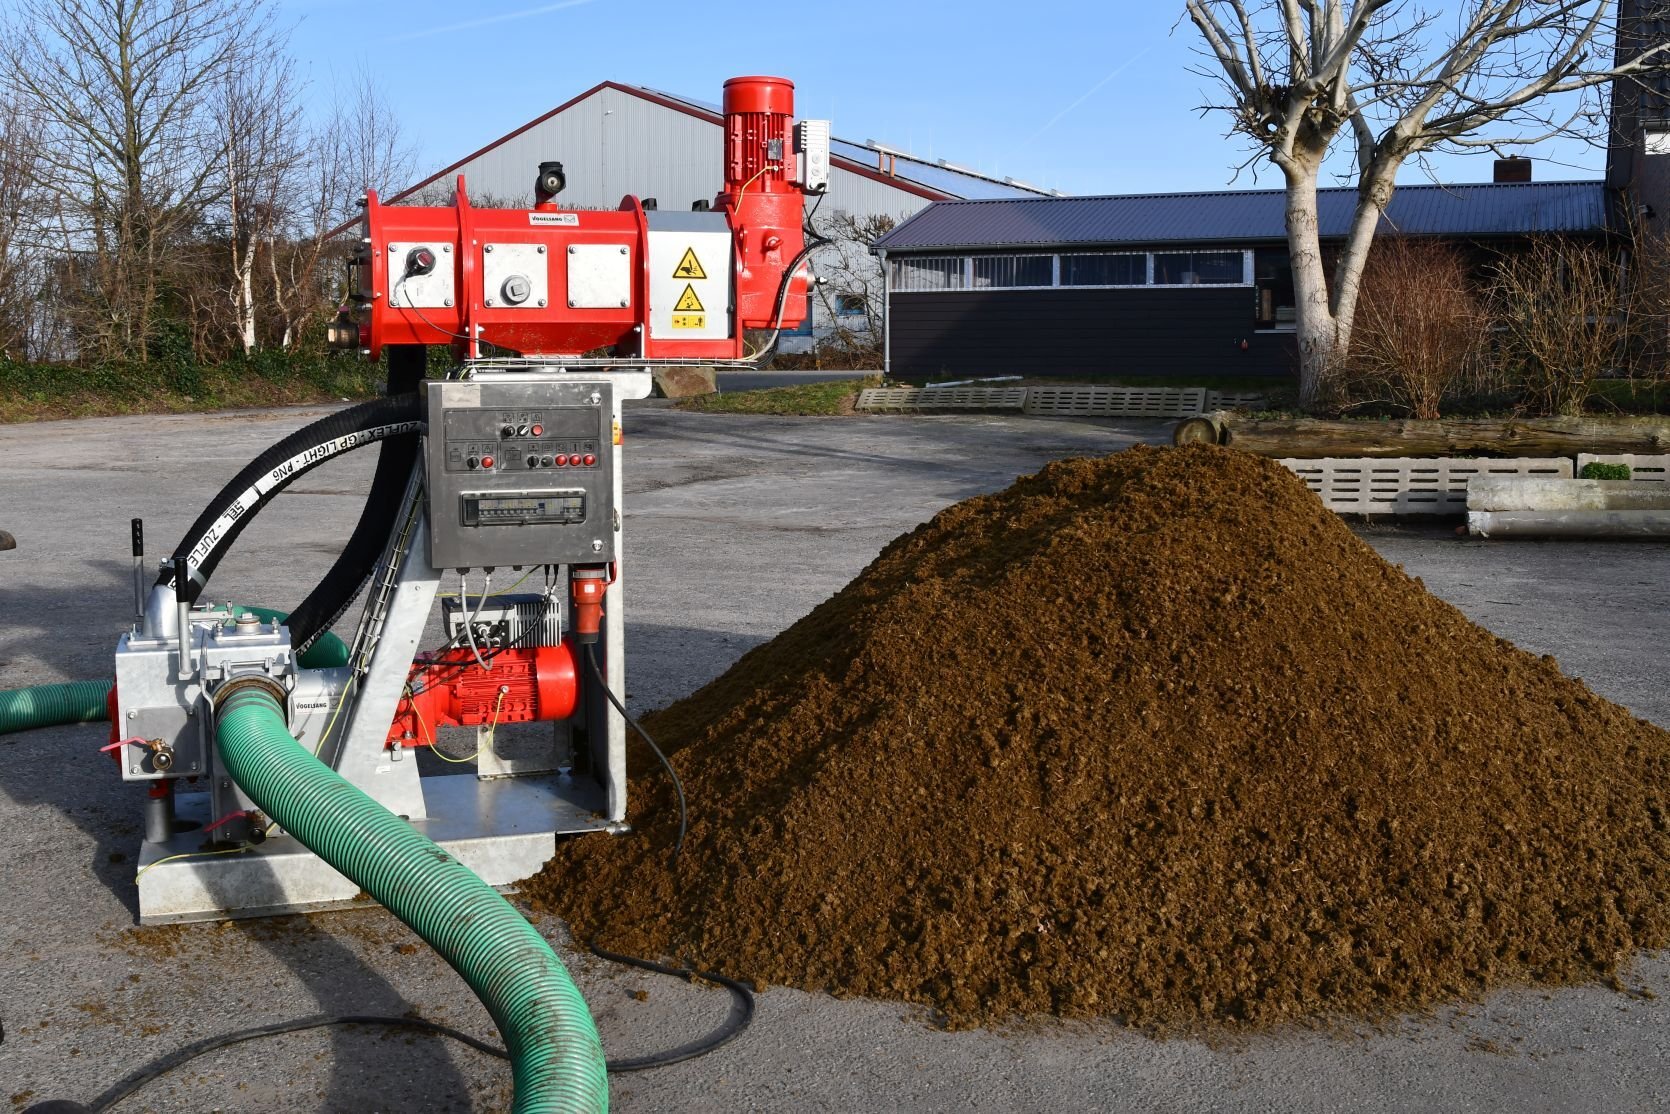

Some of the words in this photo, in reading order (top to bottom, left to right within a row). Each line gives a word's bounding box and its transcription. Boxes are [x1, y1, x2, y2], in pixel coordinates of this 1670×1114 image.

[369, 422, 418, 438] ZUFLEX
[340, 436, 358, 449] GP
[303, 443, 338, 463] LIGHT
[273, 461, 294, 482] PN6
[223, 500, 245, 521] SEL
[188, 528, 219, 567] ZUFLE
